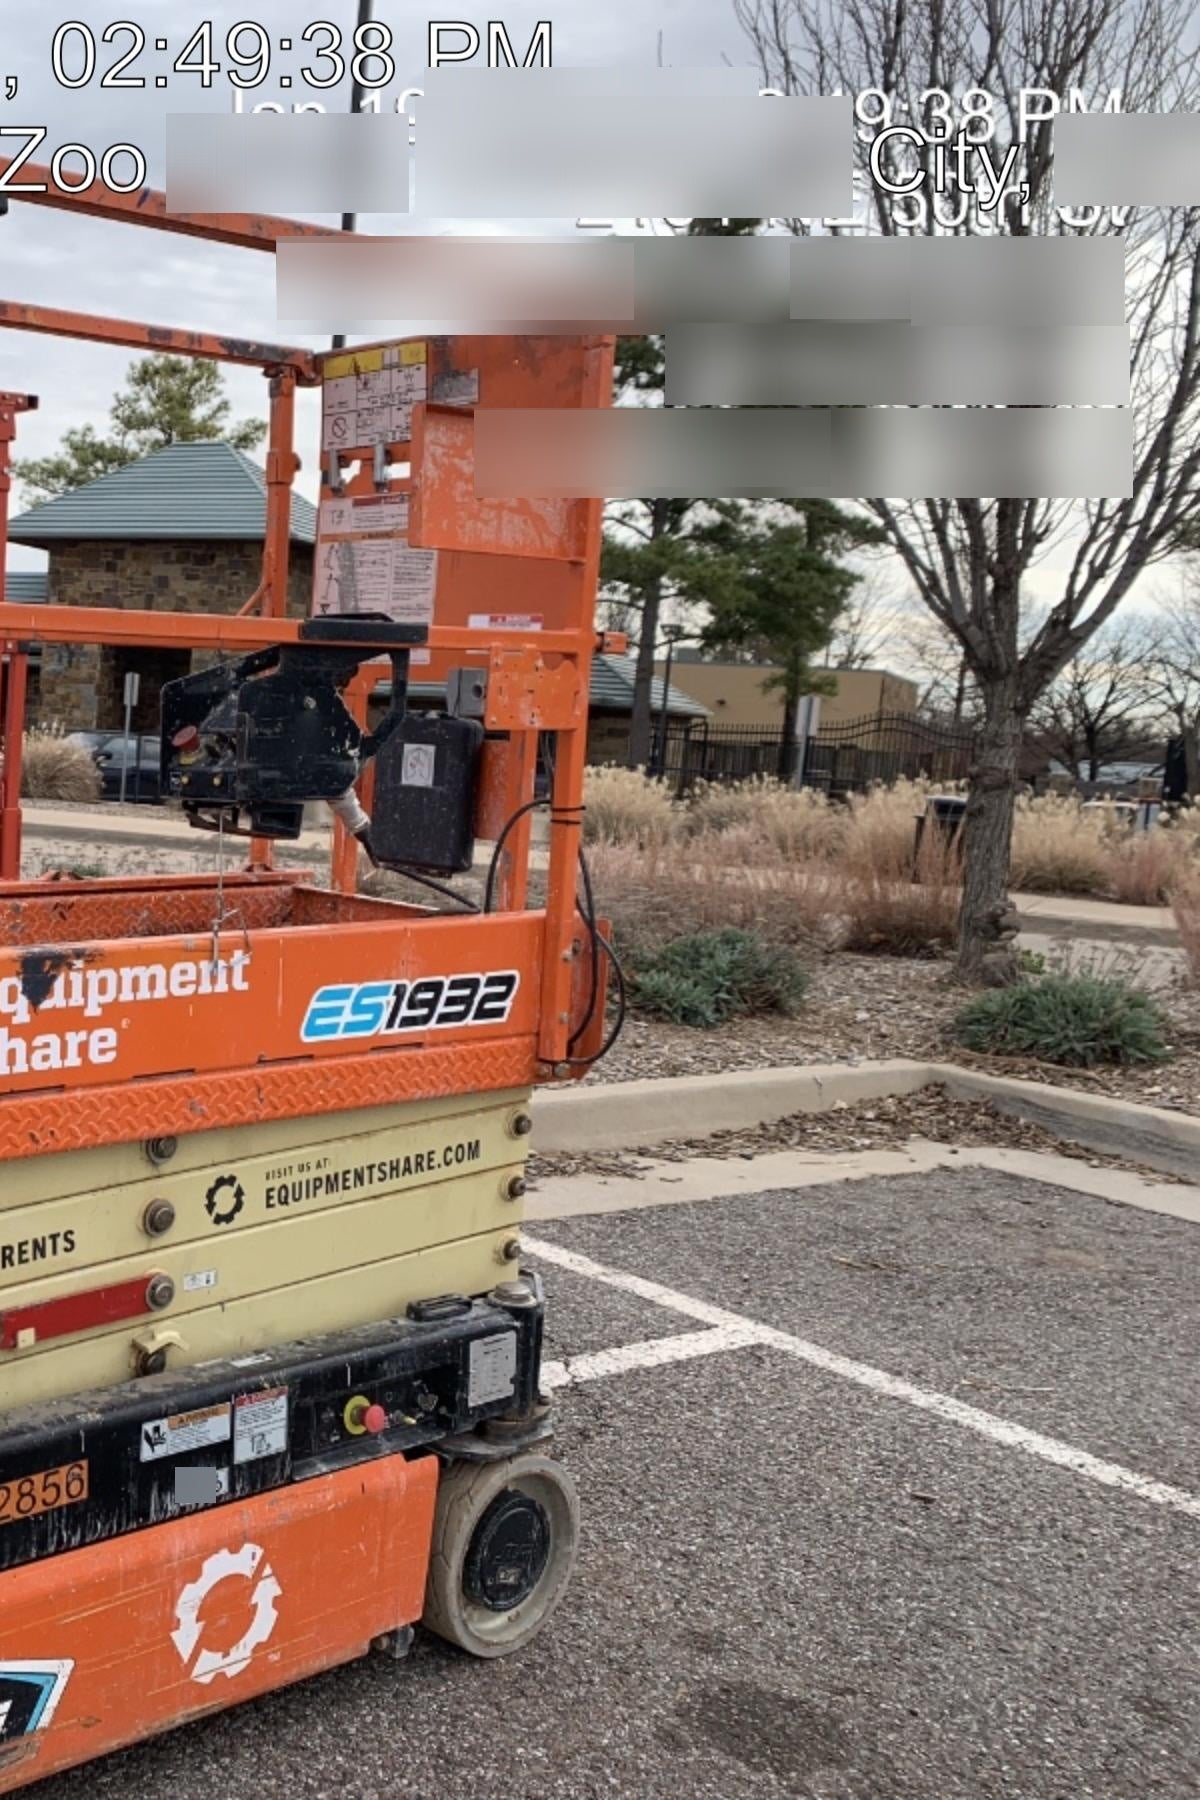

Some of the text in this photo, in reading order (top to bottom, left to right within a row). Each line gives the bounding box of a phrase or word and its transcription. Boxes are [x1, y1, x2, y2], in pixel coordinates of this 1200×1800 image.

[302, 971, 519, 1041] ES1932
[265, 1139, 481, 1209] EQUIPMENTSHARE.COM
[297, 1161, 311, 1173] US
[315, 1157, 329, 1170] AT
